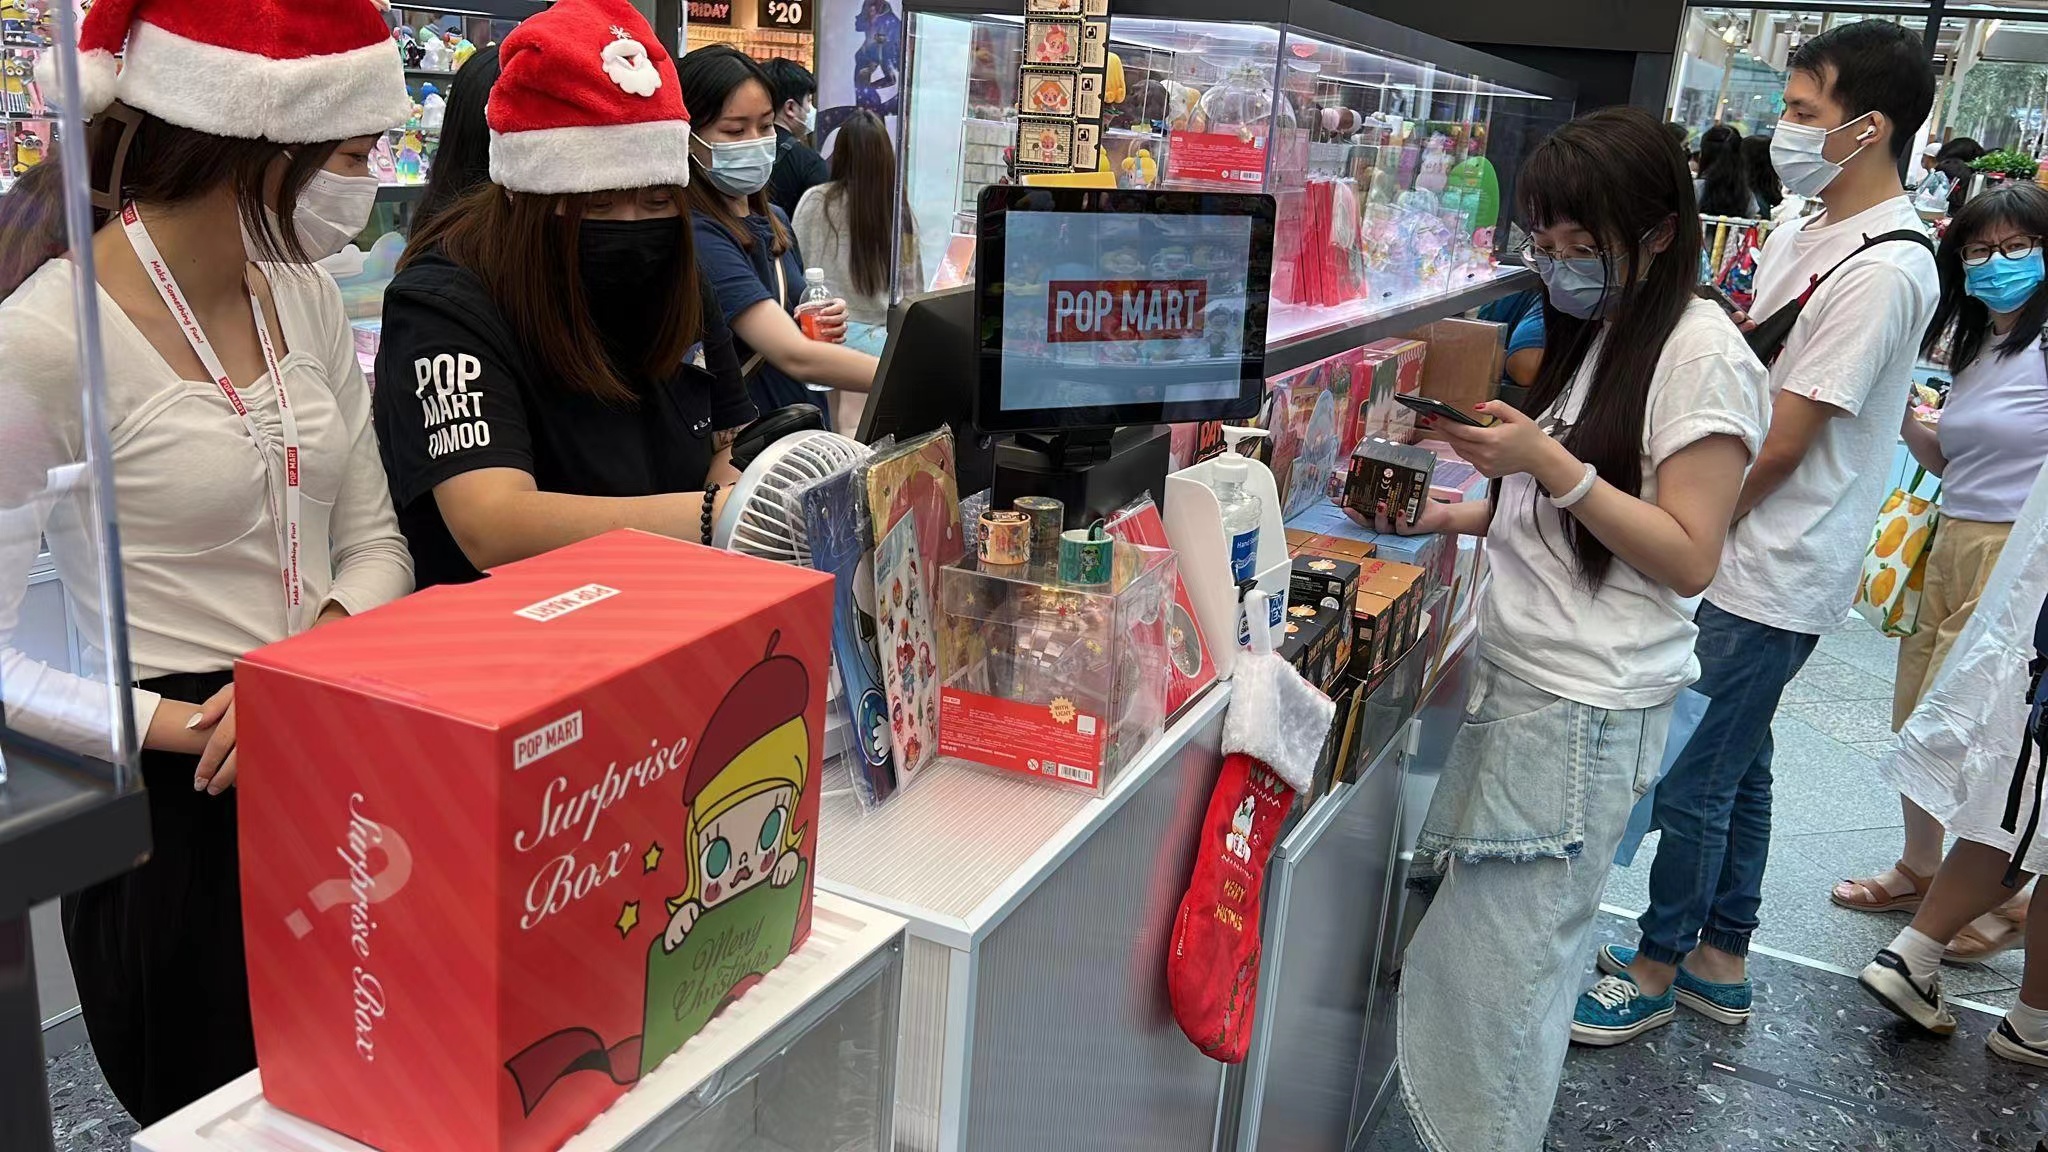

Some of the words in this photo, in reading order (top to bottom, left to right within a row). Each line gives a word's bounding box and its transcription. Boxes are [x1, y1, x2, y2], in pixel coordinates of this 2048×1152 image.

[768, 1, 802, 24] $20
[151, 260, 167, 282] Make
[164, 283, 192, 325] Something
[190, 326, 204, 344] Fun!
[1055, 290, 1113, 332] POP
[1121, 289, 1199, 331] MART
[221, 379, 234, 394] POP
[230, 394, 246, 415] MART
[414, 353, 481, 399] POP
[422, 392, 483, 428] MART
[289, 449, 297, 470] MART
[429, 421, 490, 459] DIMOO
[518, 735, 543, 763] POP
[546, 717, 579, 750] MART
[514, 736, 693, 852] Surprise
[336, 792, 382, 961] Surprise
[520, 840, 632, 930] Box
[350, 966, 386, 1063] Box
